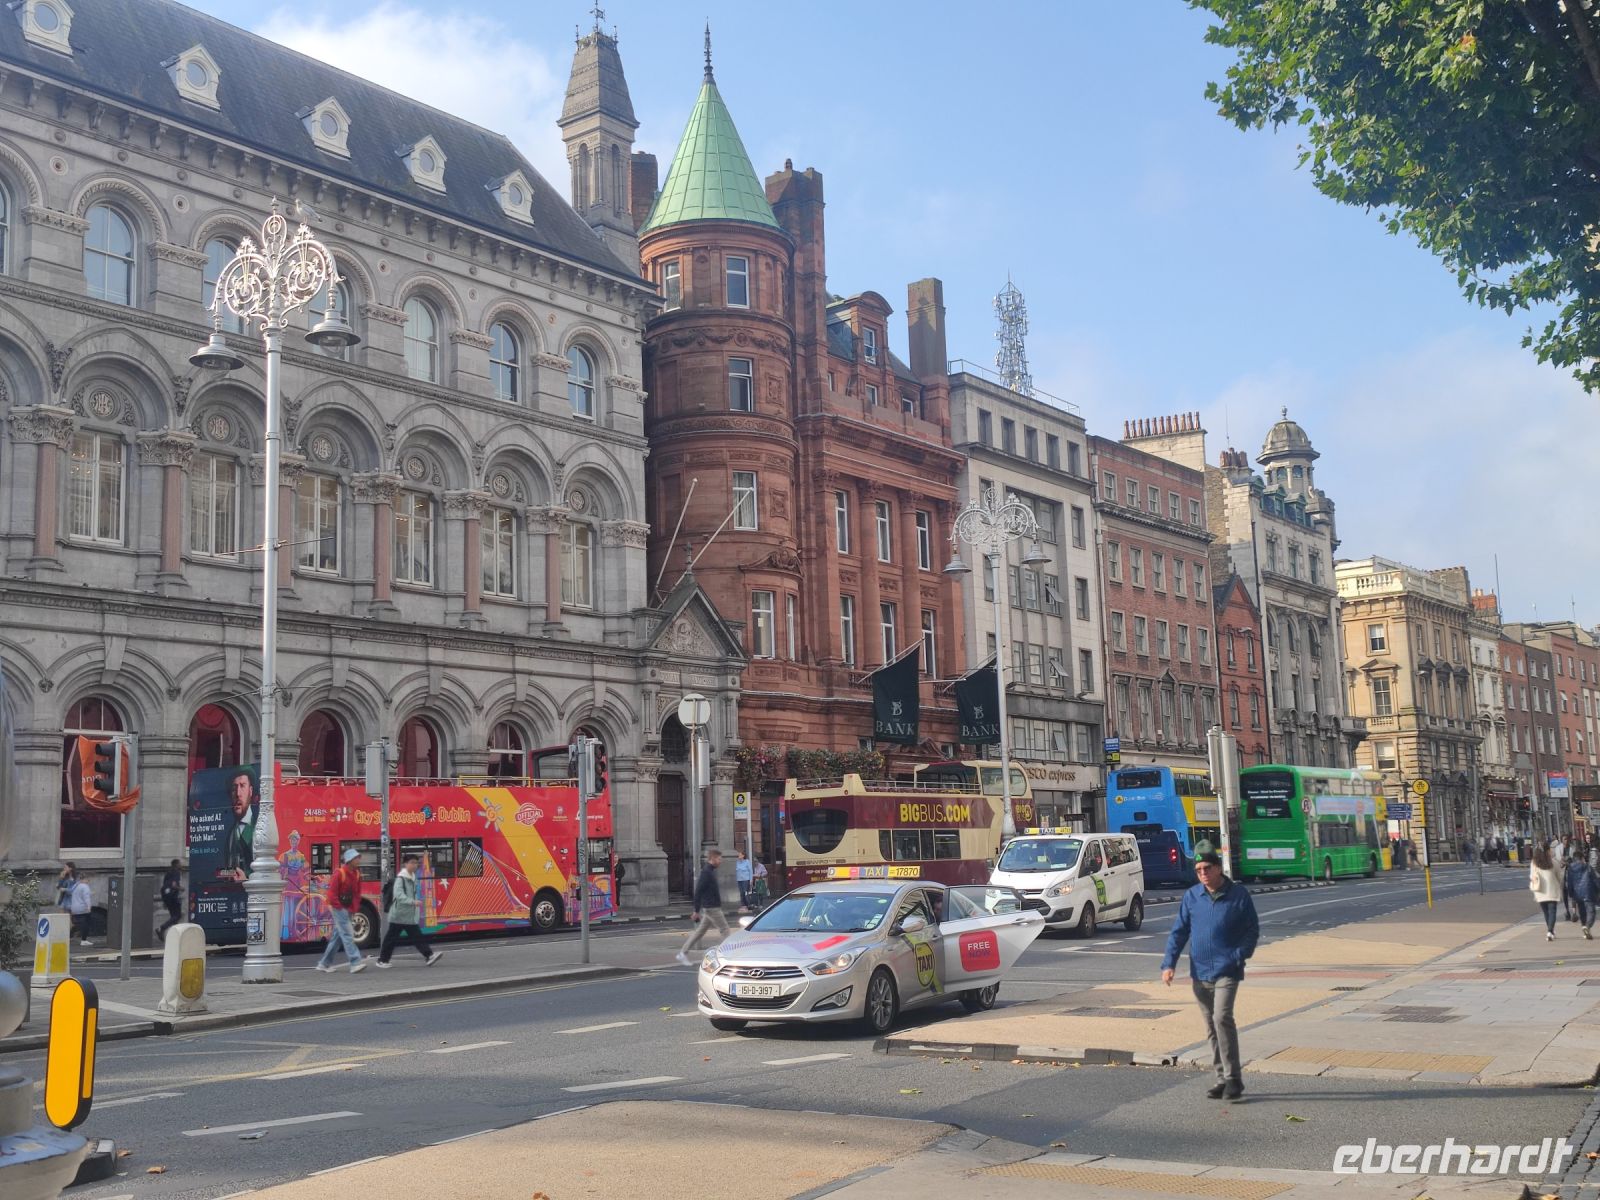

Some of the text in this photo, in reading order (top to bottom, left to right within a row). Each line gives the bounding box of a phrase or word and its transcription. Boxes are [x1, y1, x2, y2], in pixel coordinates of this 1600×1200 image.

[876, 720, 915, 736] BANK
[962, 723, 1000, 737] BANK
[1049, 770, 1076, 784] express
[190, 815, 199, 823] We
[199, 814, 215, 822] asked
[354, 809, 373, 826] City
[437, 806, 471, 823] Dublin
[516, 809, 542, 821] OFFICIAL
[899, 803, 971, 823] BIGBUS.COM
[197, 824, 210, 832] show
[864, 866, 919, 877] TAXI 17870
[198, 902, 217, 913] EPIC
[967, 941, 991, 951] FREE
[917, 954, 933, 973] TAXI
